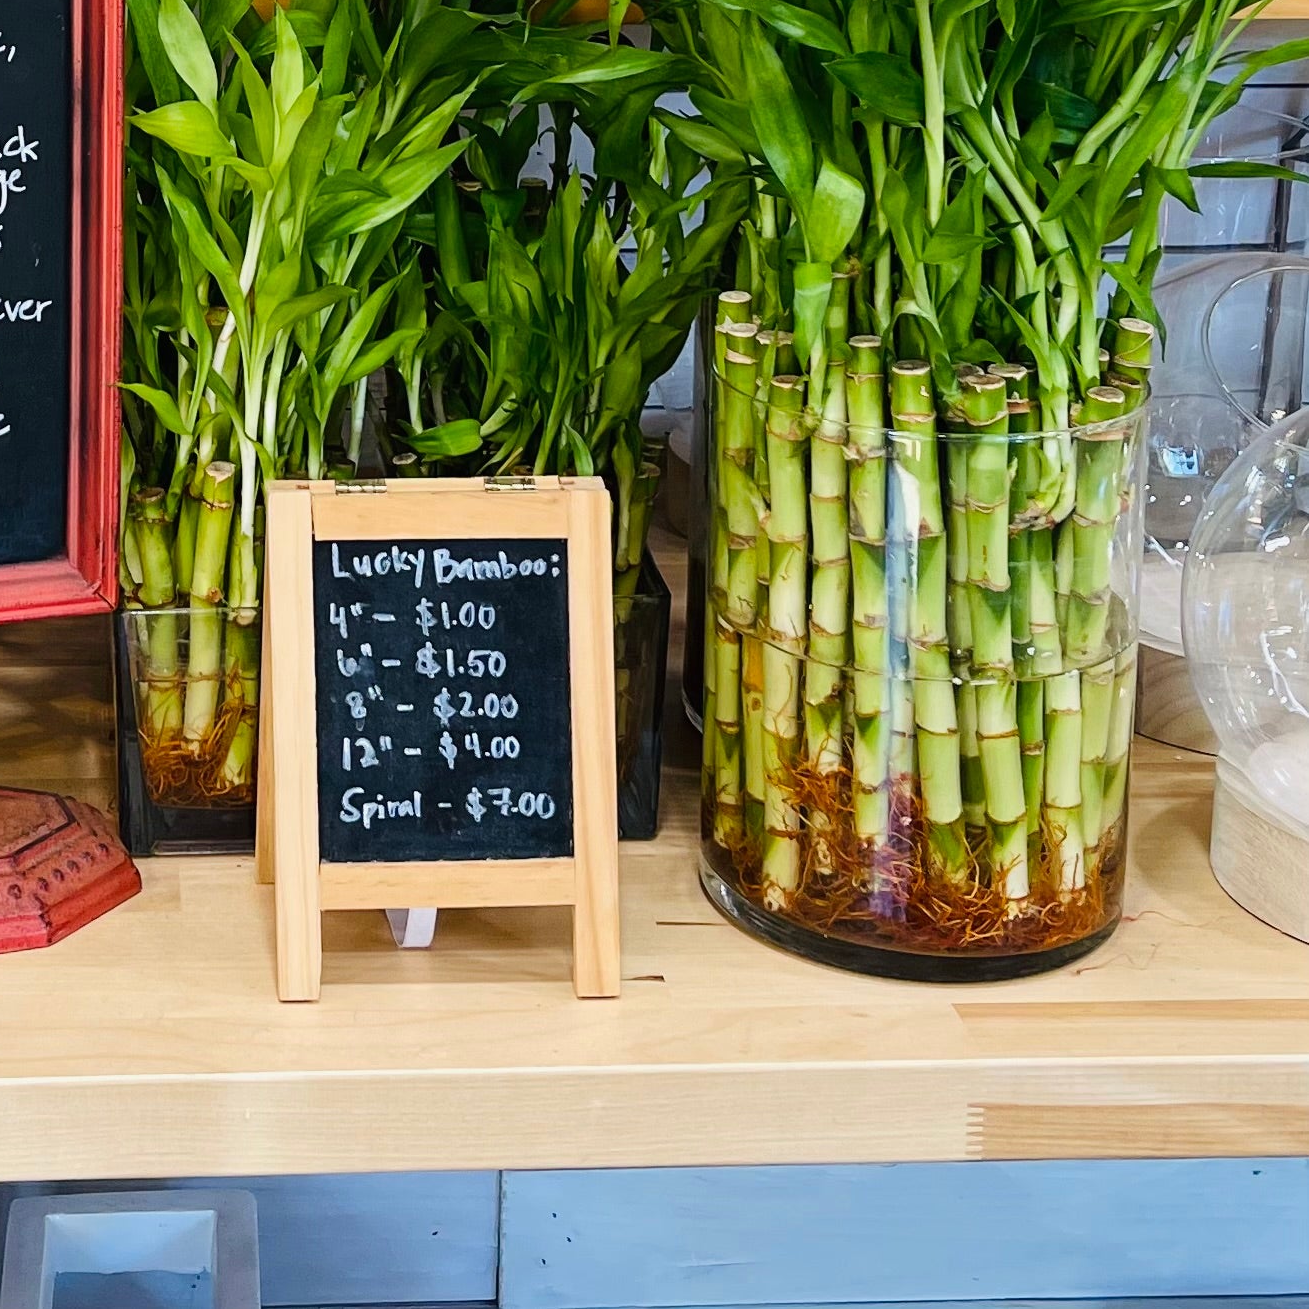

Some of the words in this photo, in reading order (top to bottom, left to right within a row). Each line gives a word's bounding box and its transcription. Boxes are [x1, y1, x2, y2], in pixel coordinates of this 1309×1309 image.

[331, 543, 426, 589] Lucky
[433, 547, 561, 585] Bamboo:
[415, 597, 497, 637] $1.00
[415, 641, 507, 679] $1.50
[433, 687, 520, 728] $2.00
[439, 731, 521, 770] $4.00
[340, 787, 423, 829] Spiral
[465, 787, 556, 823] $7.00
